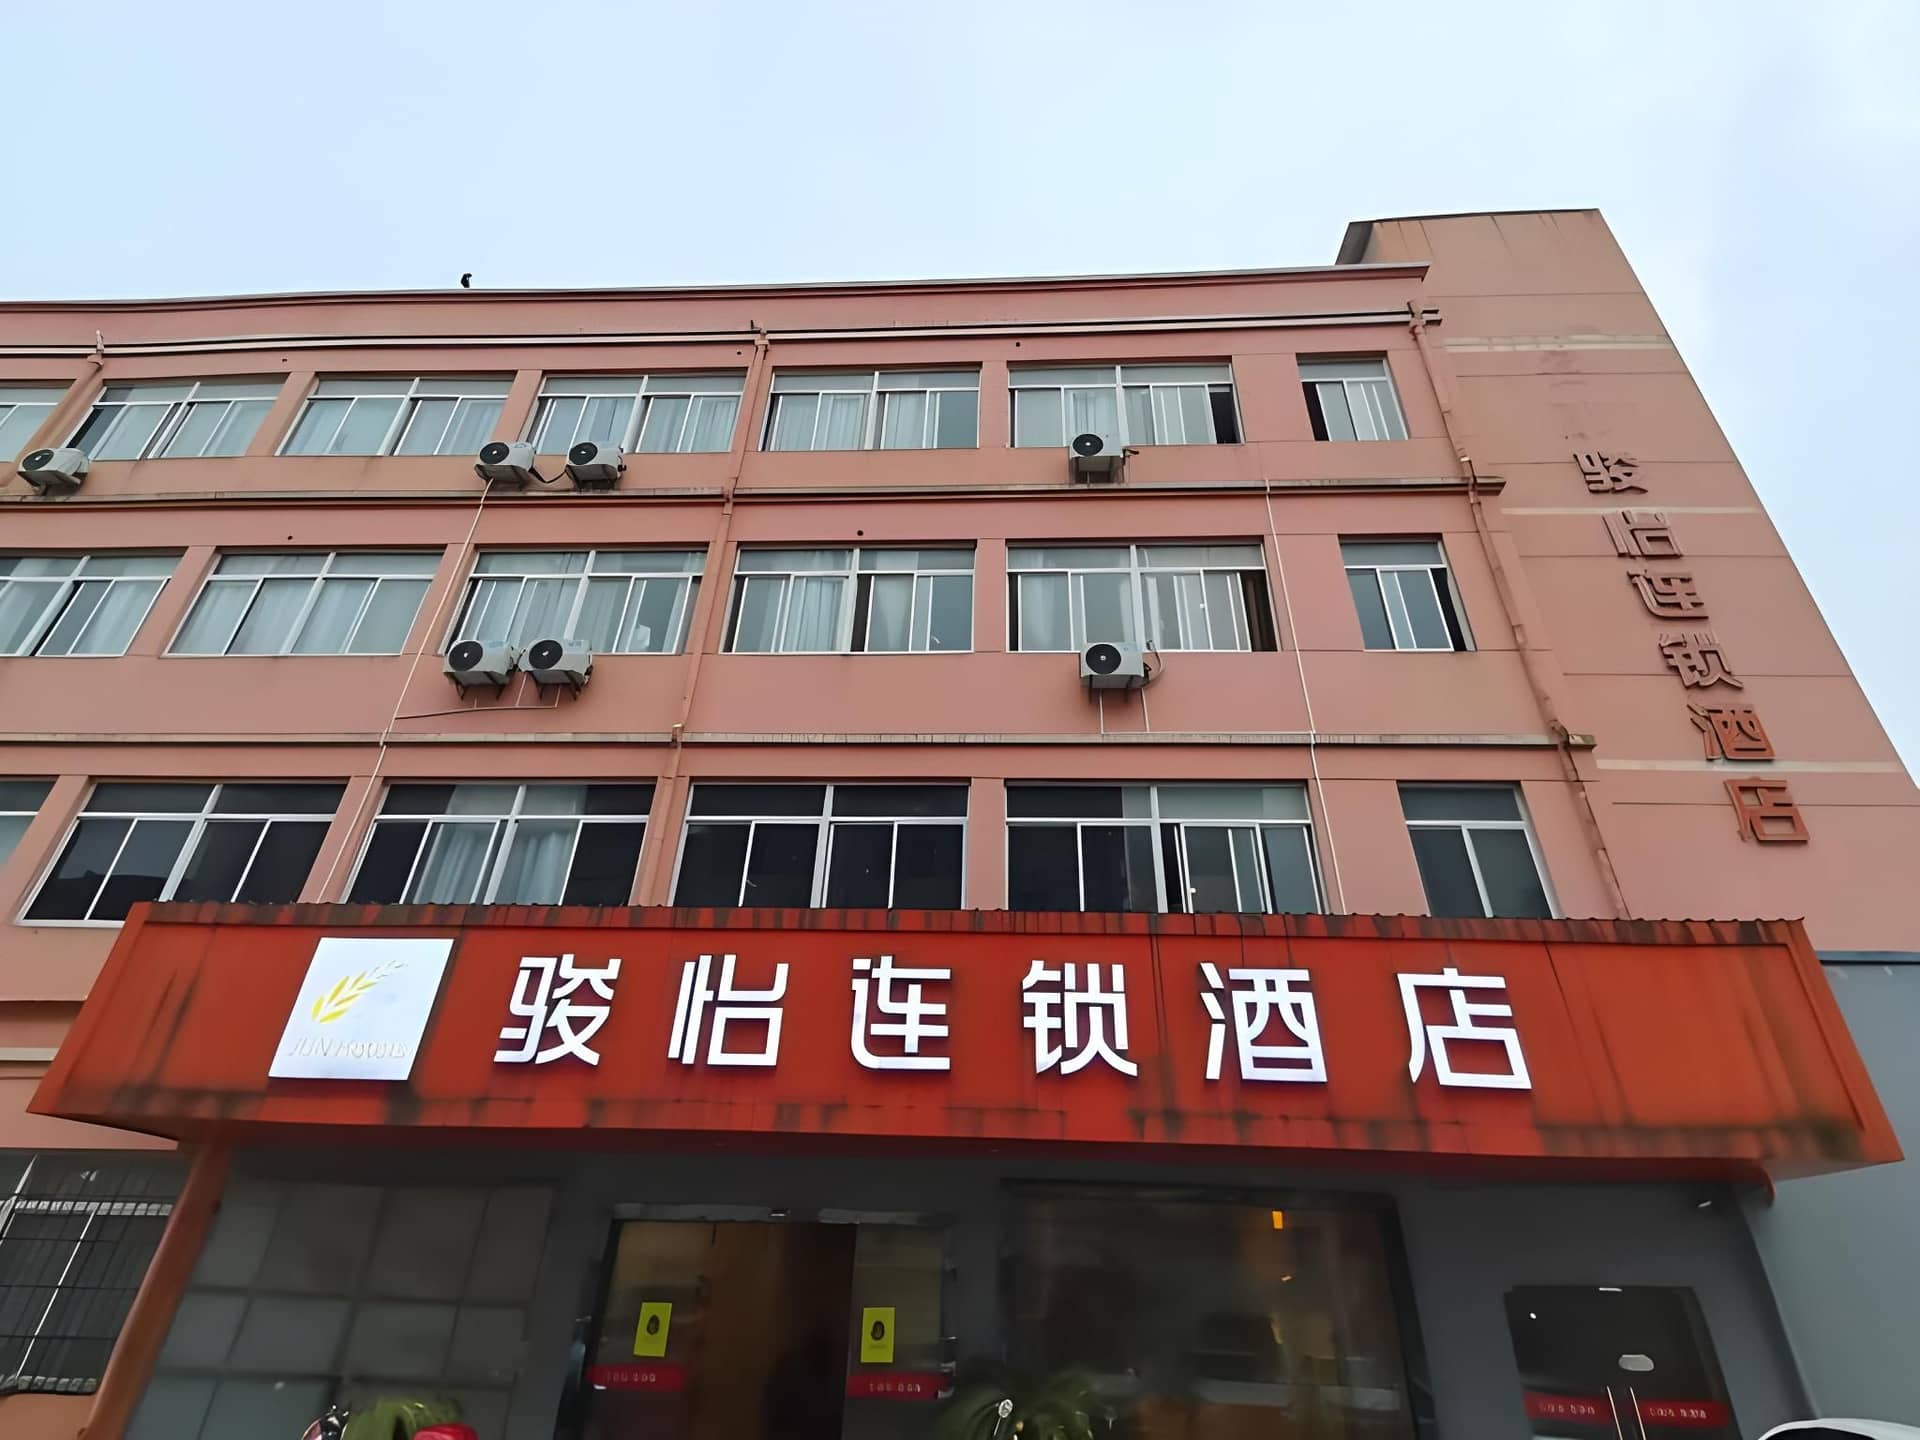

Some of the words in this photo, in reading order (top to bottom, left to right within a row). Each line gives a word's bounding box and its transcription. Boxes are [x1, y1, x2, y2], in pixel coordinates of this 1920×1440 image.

[1573, 450, 1810, 842] 骏怡连锁酒店
[494, 954, 1532, 1090] 骏怡连锁酒店
